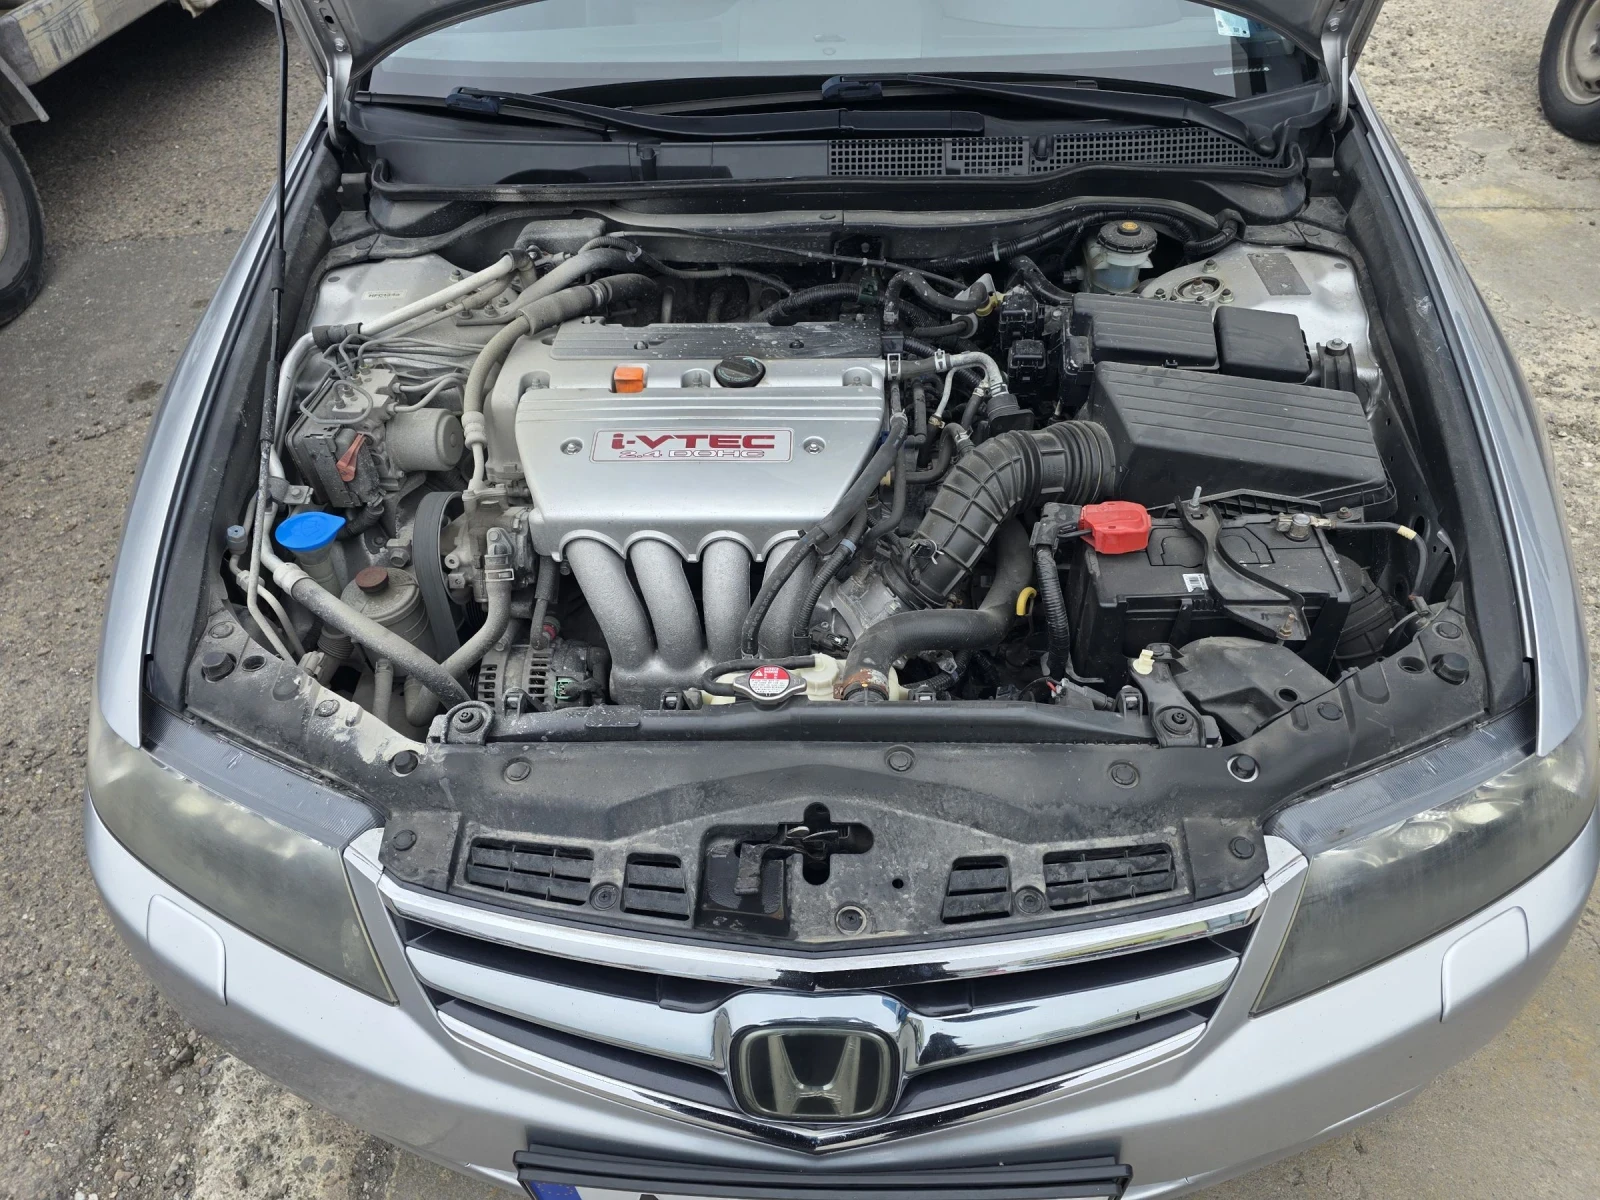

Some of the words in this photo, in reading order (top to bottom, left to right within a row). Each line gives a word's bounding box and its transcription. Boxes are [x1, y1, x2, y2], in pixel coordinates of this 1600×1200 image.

[611, 433, 775, 450] i-VTEC
[619, 450, 662, 458] 2.4
[668, 450, 764, 458] DOHC
